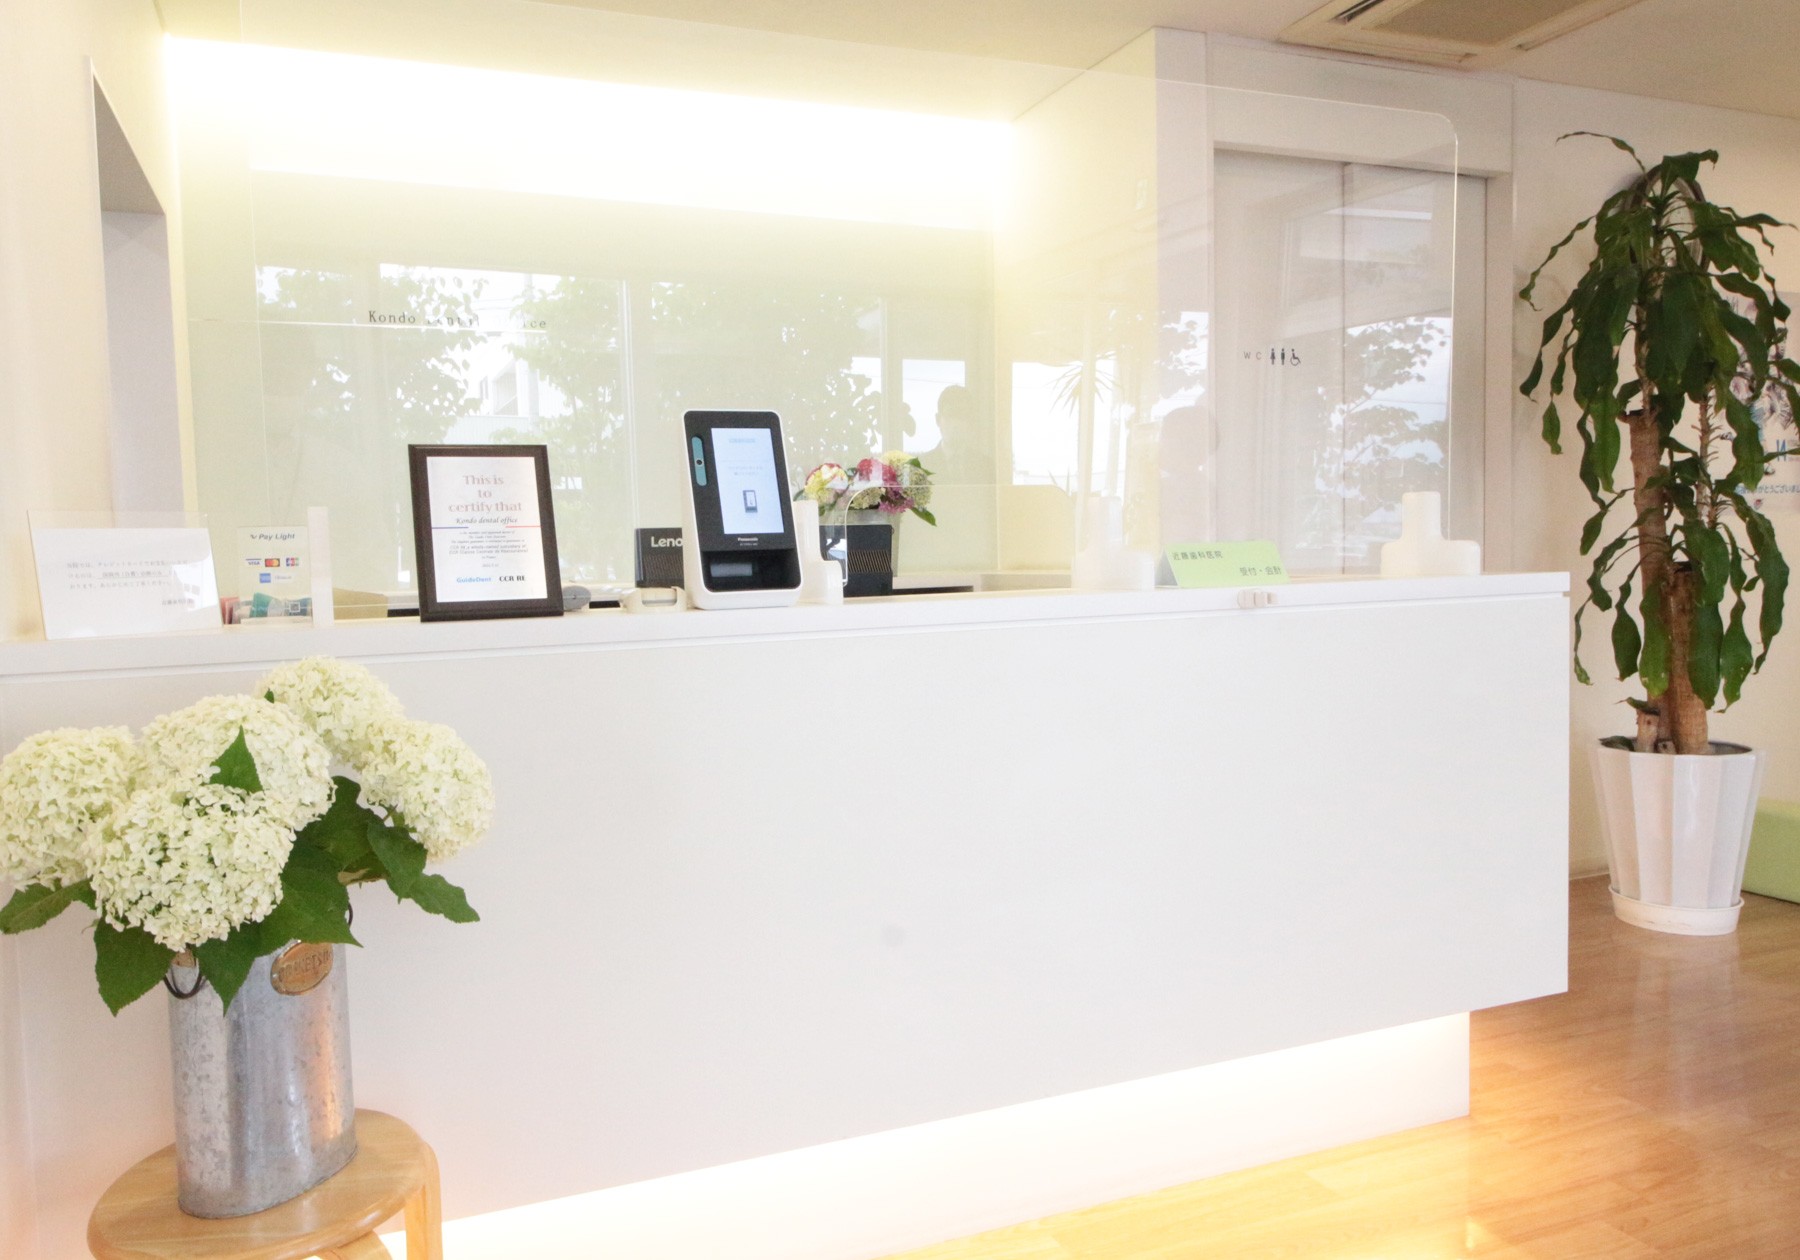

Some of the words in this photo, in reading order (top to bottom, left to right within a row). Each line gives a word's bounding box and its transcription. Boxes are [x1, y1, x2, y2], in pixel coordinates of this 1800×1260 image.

[368, 310, 416, 324] Kondo
[427, 313, 480, 327] ntl
[462, 475, 493, 485] This
[494, 475, 504, 485] is
[478, 489, 492, 498] to
[448, 501, 492, 513] certify
[495, 501, 522, 512] that
[456, 517, 477, 525] Kondo
[478, 516, 499, 524] dental
[500, 517, 518, 525] office
[258, 533, 273, 541] Pay
[275, 532, 295, 541] Light
